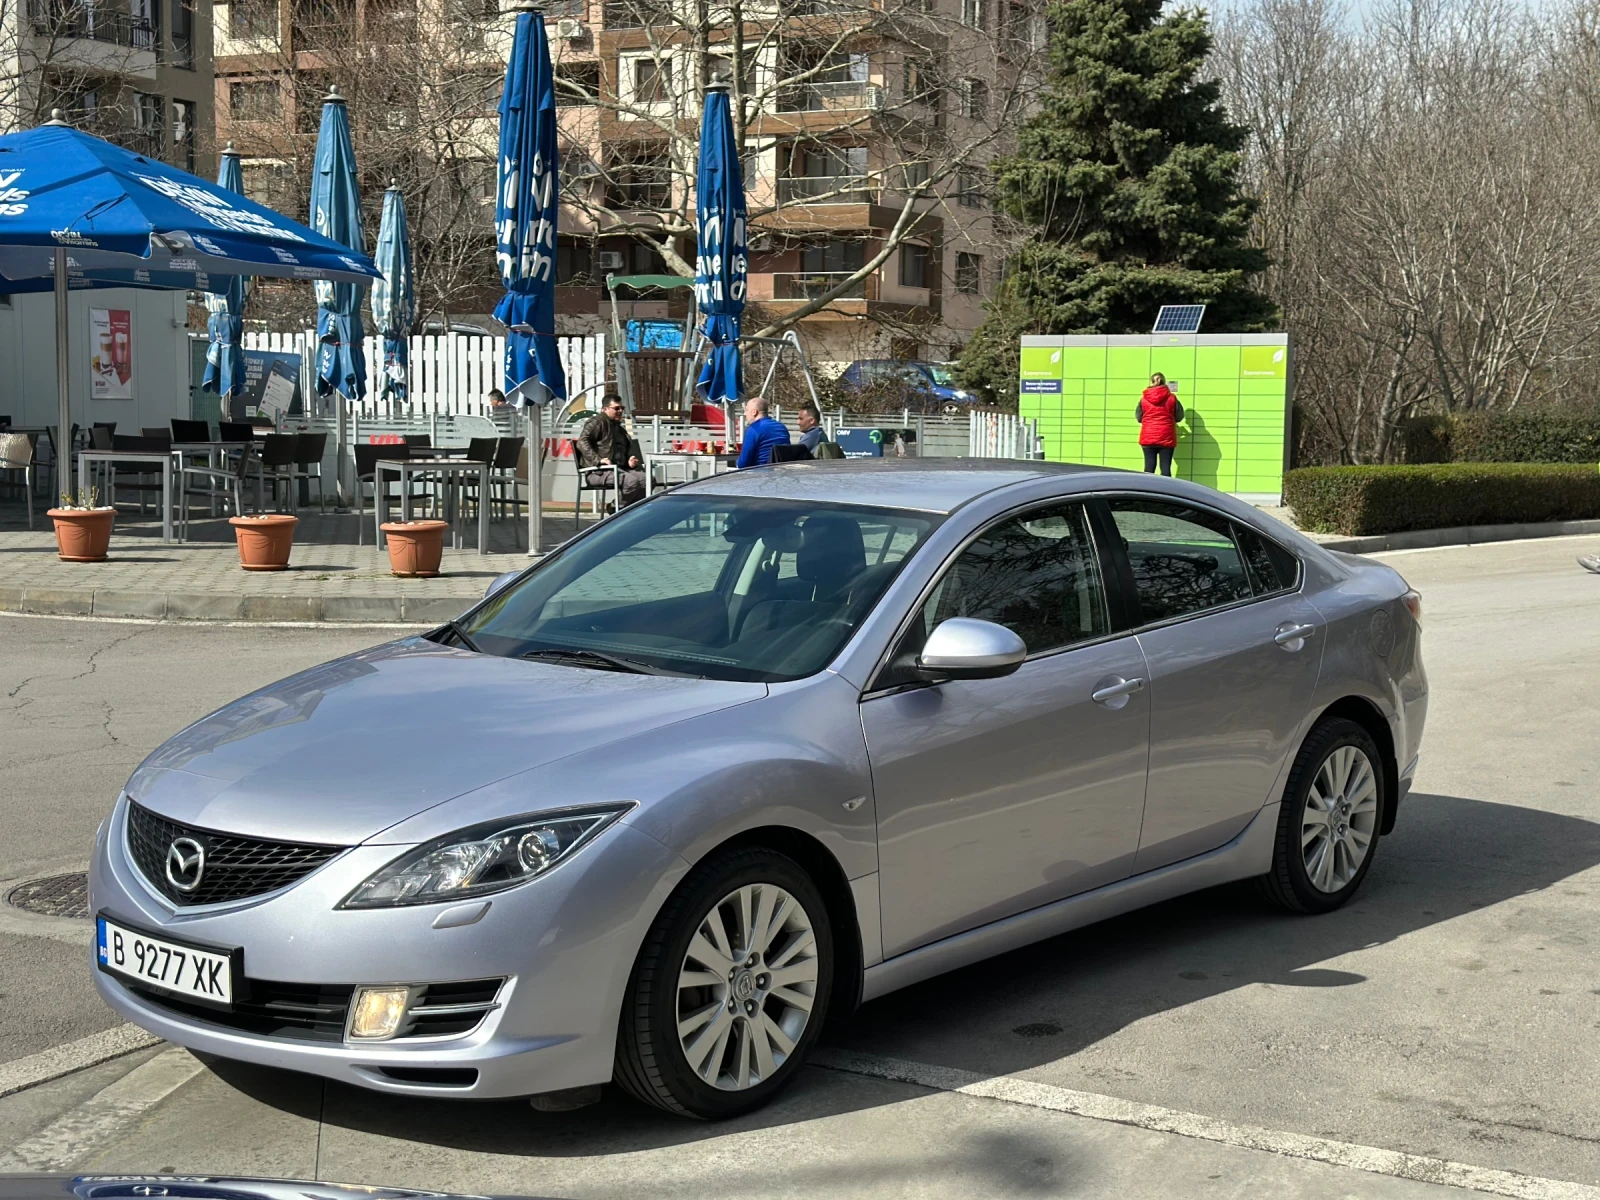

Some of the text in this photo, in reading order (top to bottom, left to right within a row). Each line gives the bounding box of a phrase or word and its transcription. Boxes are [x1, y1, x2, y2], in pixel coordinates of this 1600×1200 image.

[99, 930, 225, 997] BG B 9277 XK
